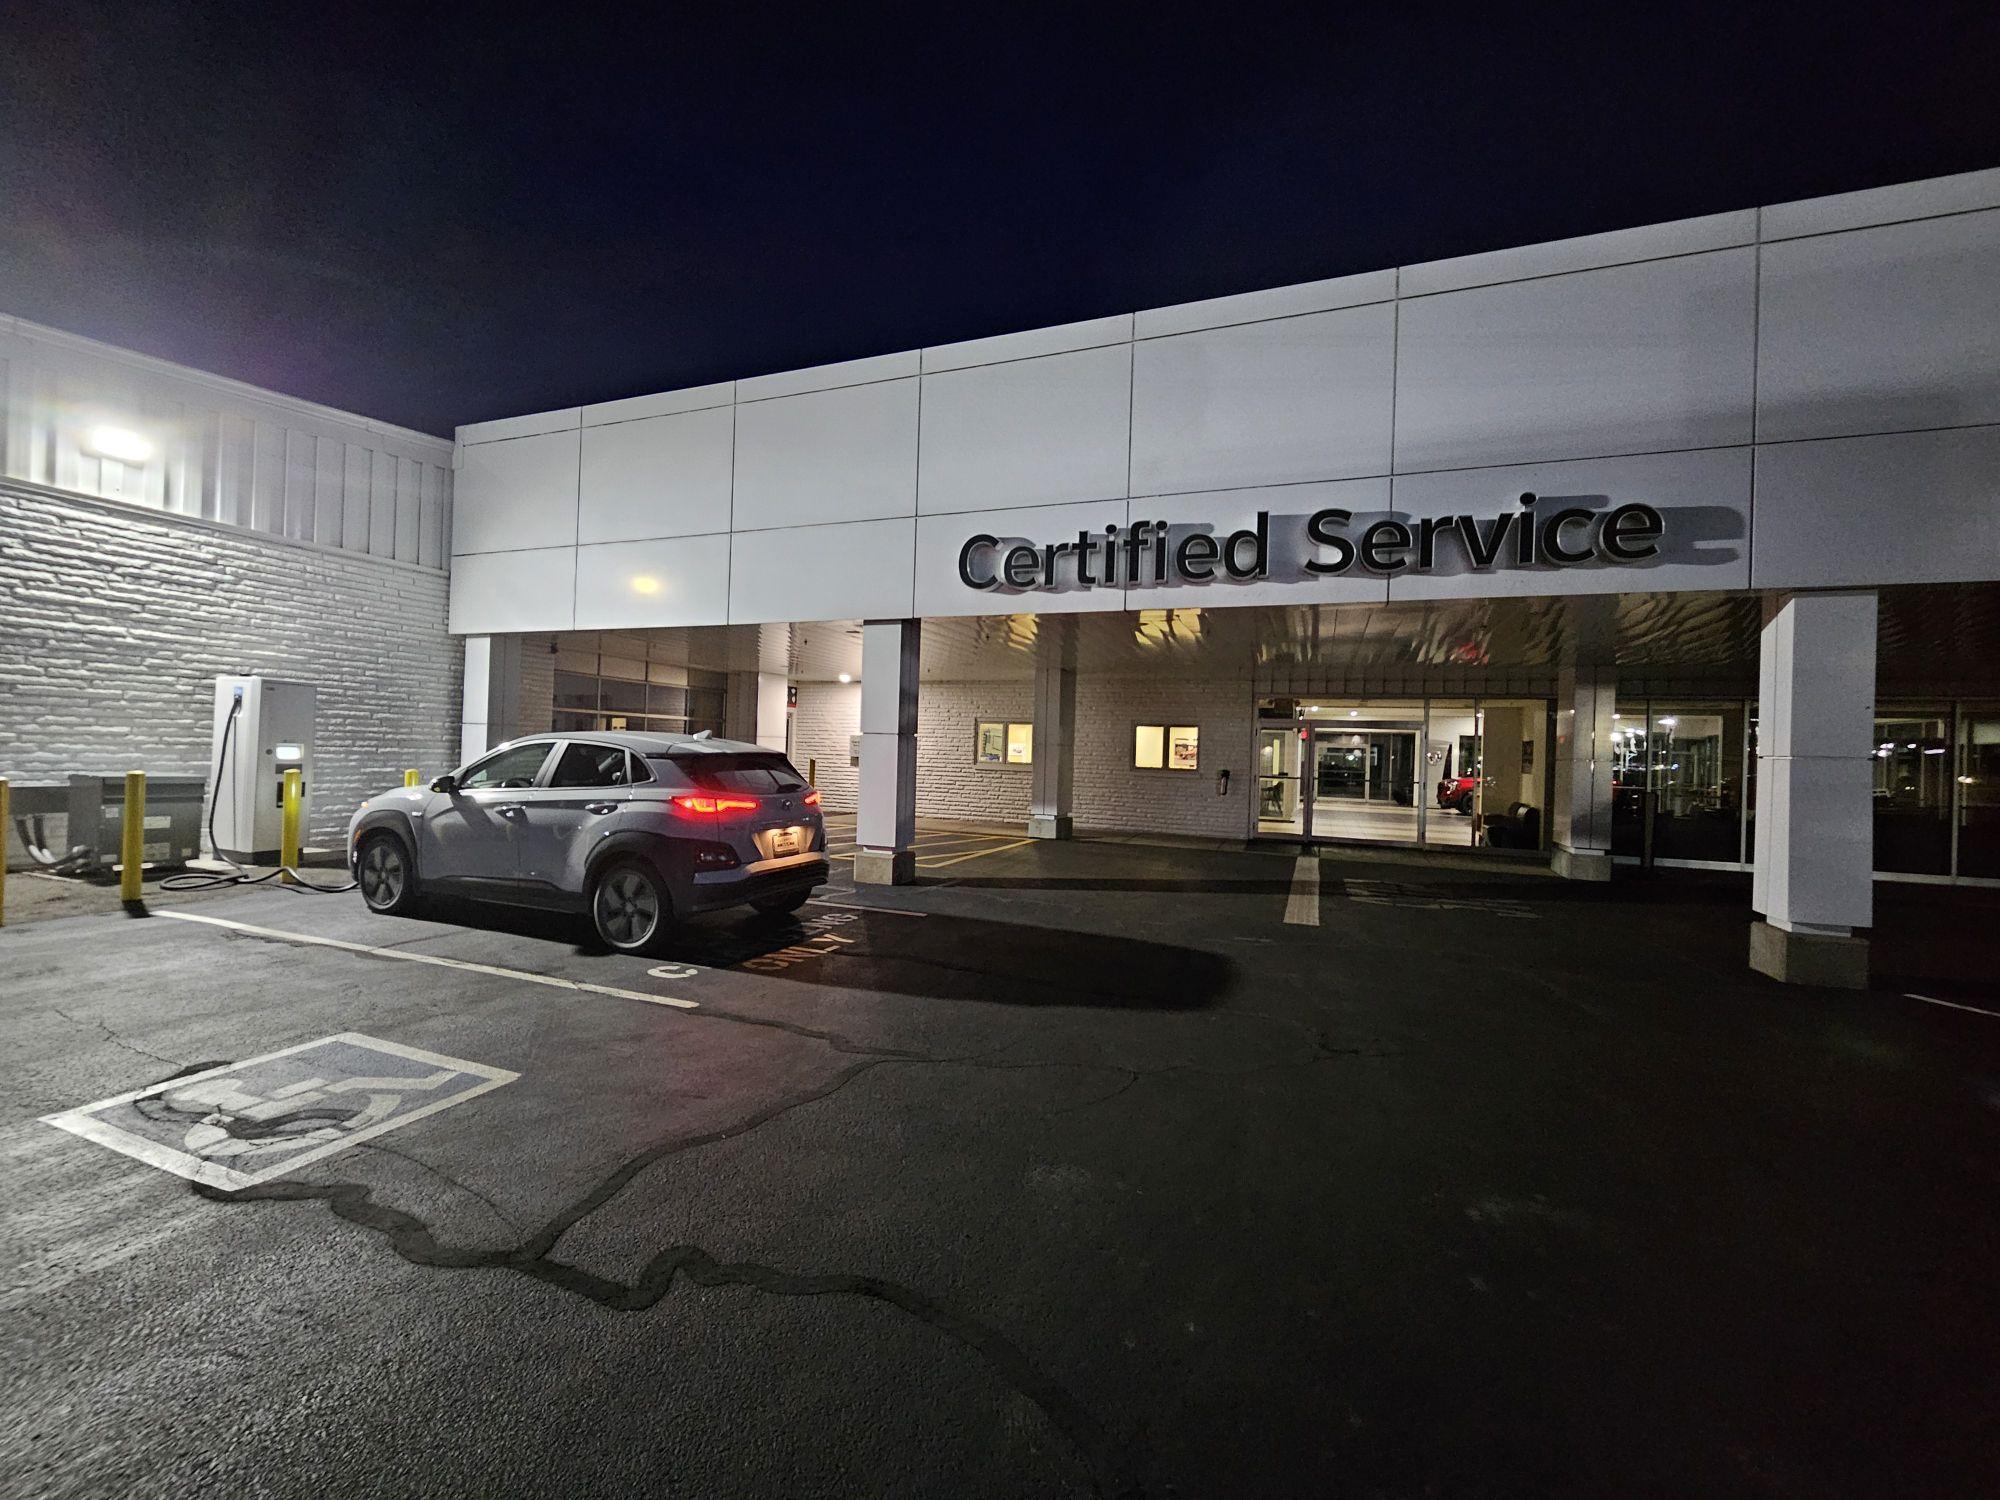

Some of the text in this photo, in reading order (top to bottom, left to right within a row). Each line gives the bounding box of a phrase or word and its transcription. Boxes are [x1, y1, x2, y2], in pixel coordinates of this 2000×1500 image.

[958, 493, 1664, 590] Certified Service
[743, 932, 855, 970] ONLY
